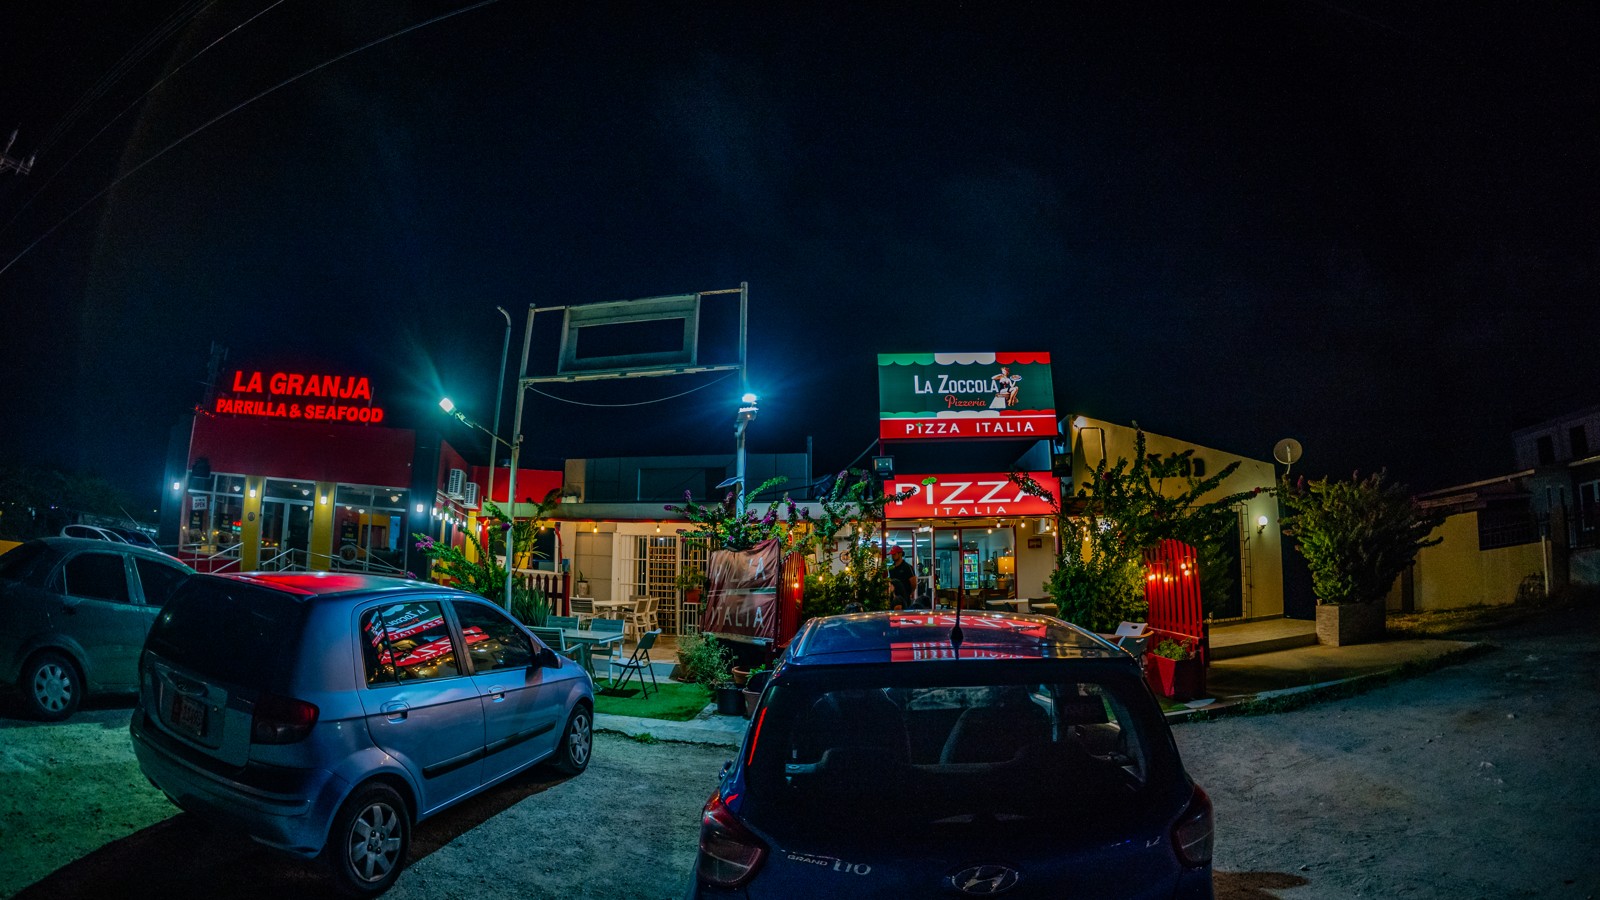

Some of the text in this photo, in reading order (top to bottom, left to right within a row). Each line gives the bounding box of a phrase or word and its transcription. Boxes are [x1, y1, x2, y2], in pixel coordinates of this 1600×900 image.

[232, 370, 371, 400] LA GRANJA
[914, 374, 1000, 394] LA ZOCCOLA
[944, 394, 987, 409] Pizzeria
[215, 398, 384, 423] PARRILLA & SEAFOOD
[905, 421, 1035, 435] PIZZA ITALIA
[934, 506, 1007, 516] ITALIA
[787, 854, 828, 866] GRAND
